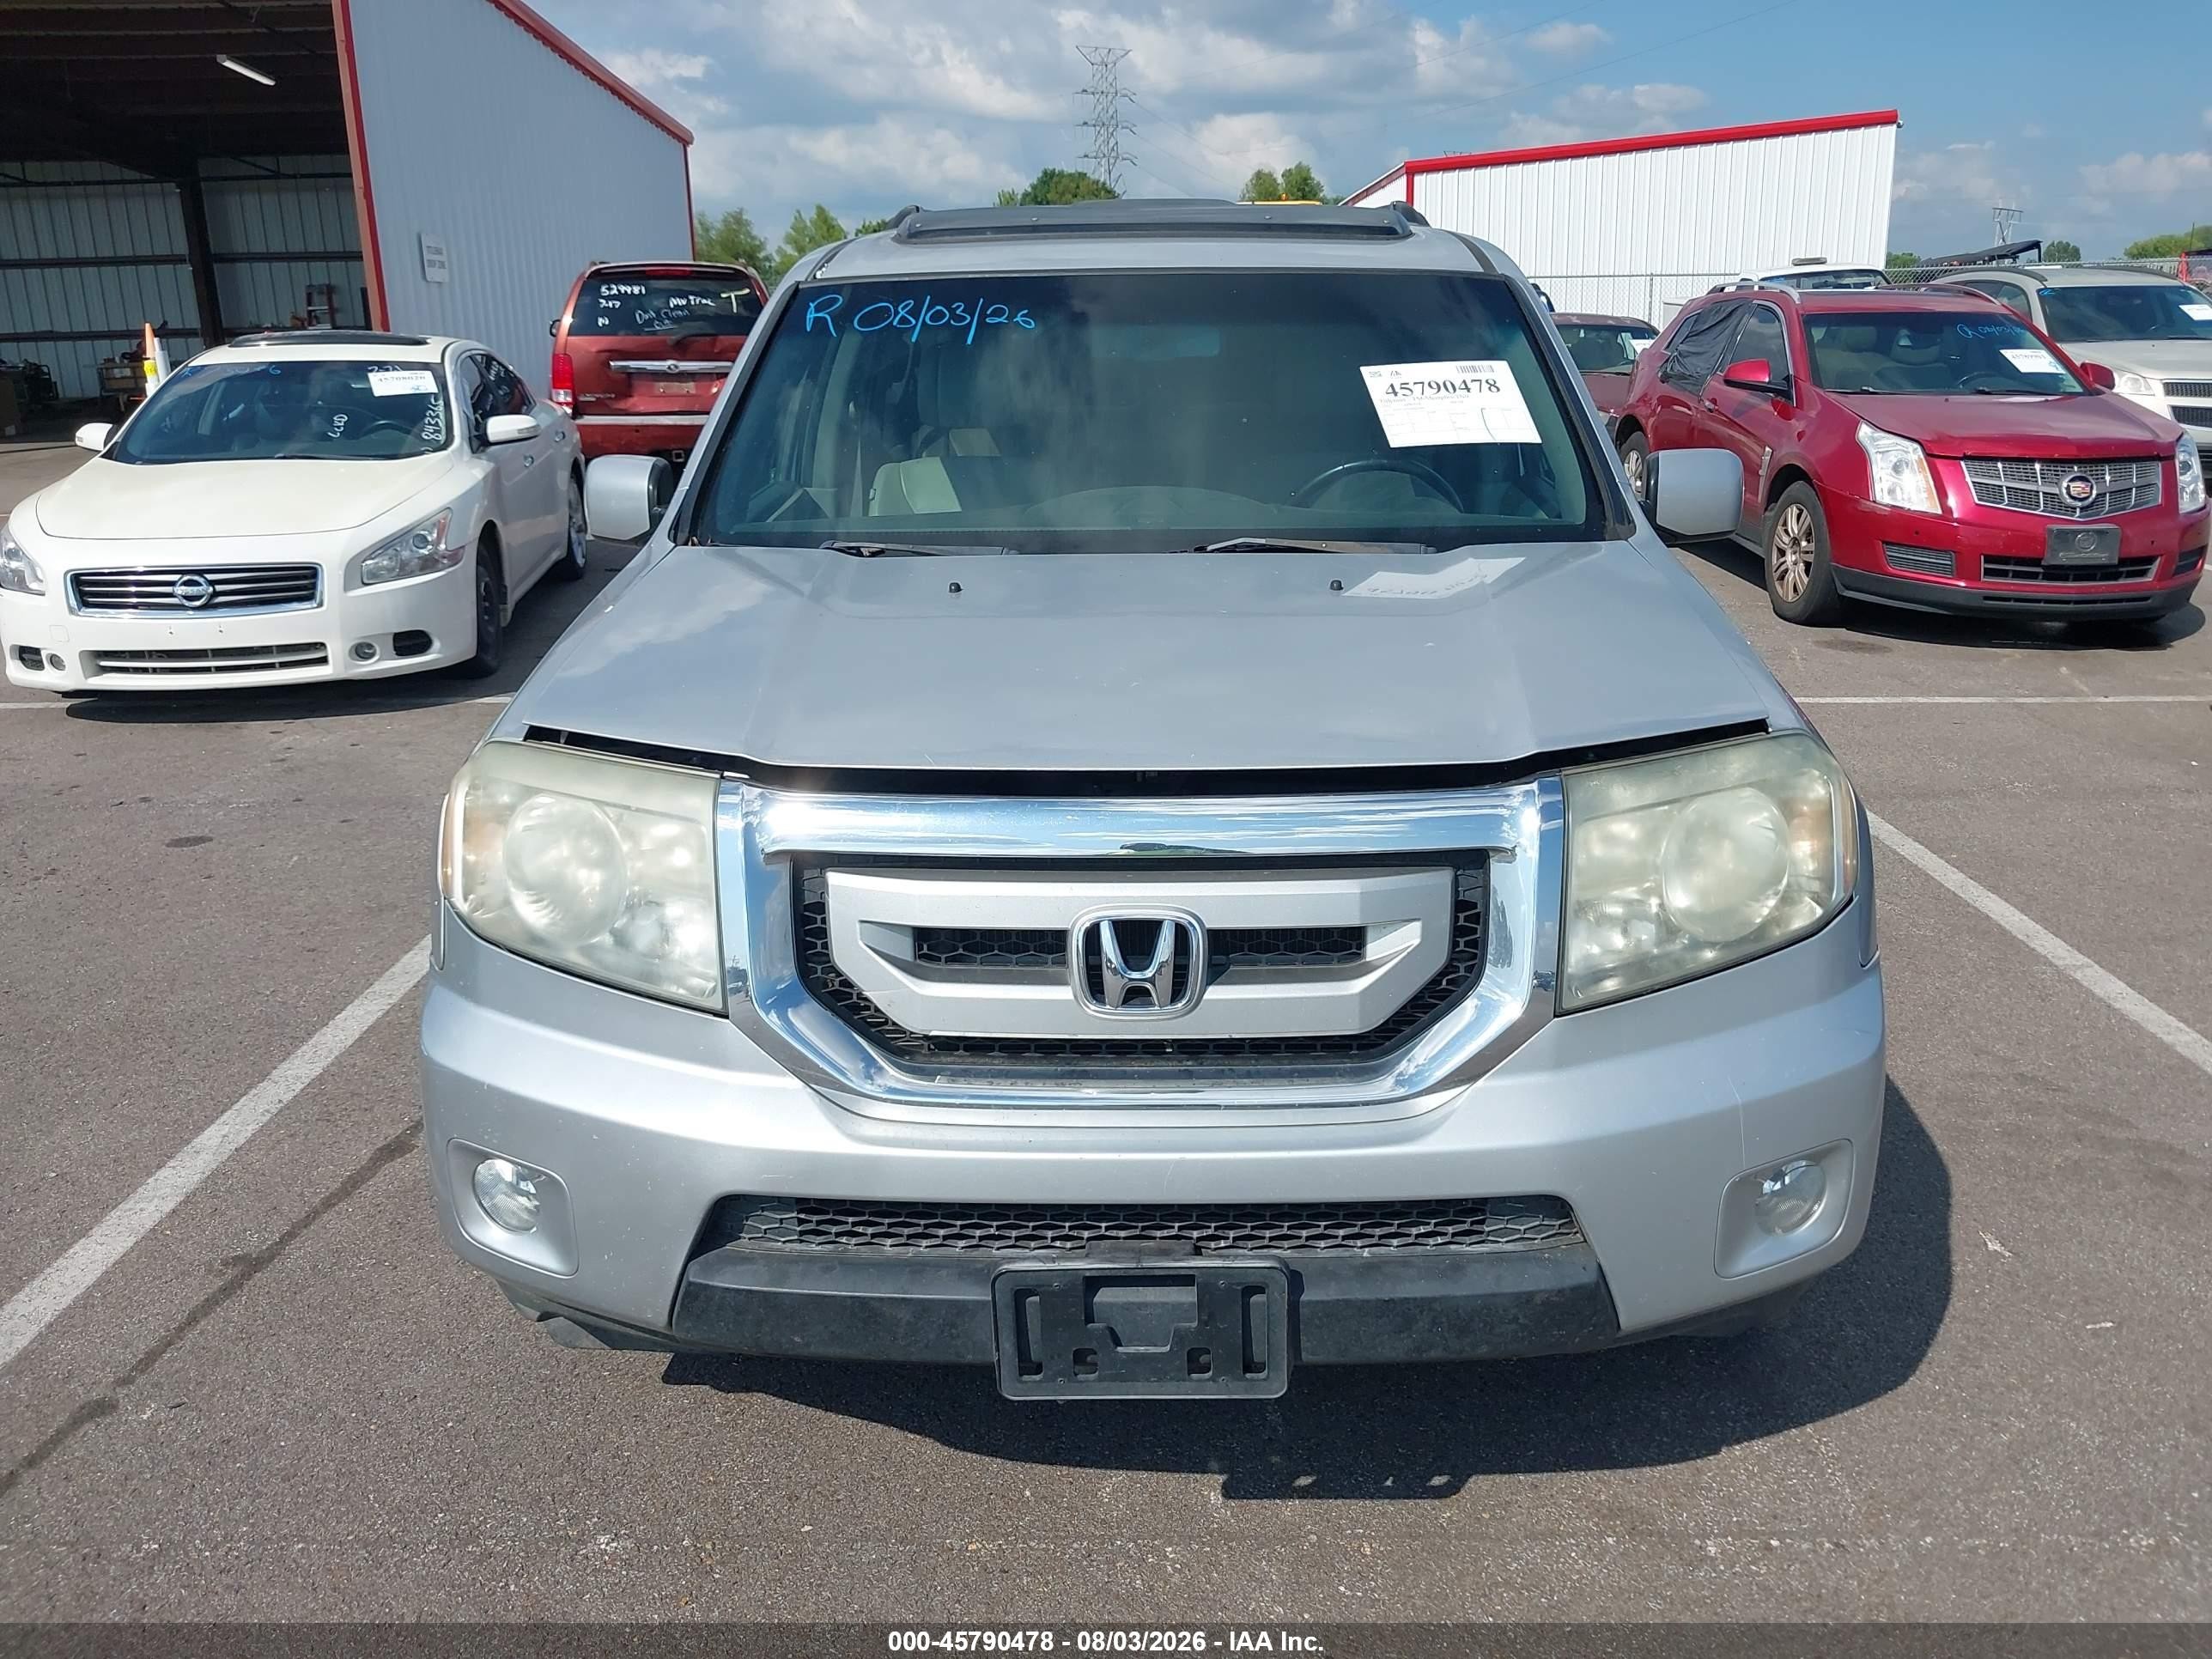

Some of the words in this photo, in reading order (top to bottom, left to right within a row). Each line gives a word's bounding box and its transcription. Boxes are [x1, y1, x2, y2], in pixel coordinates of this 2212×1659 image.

[720, 288, 750, 313] T
[806, 295, 843, 337] R
[853, 295, 1036, 345] 08/03/26
[1385, 379, 1501, 398] 45790478
